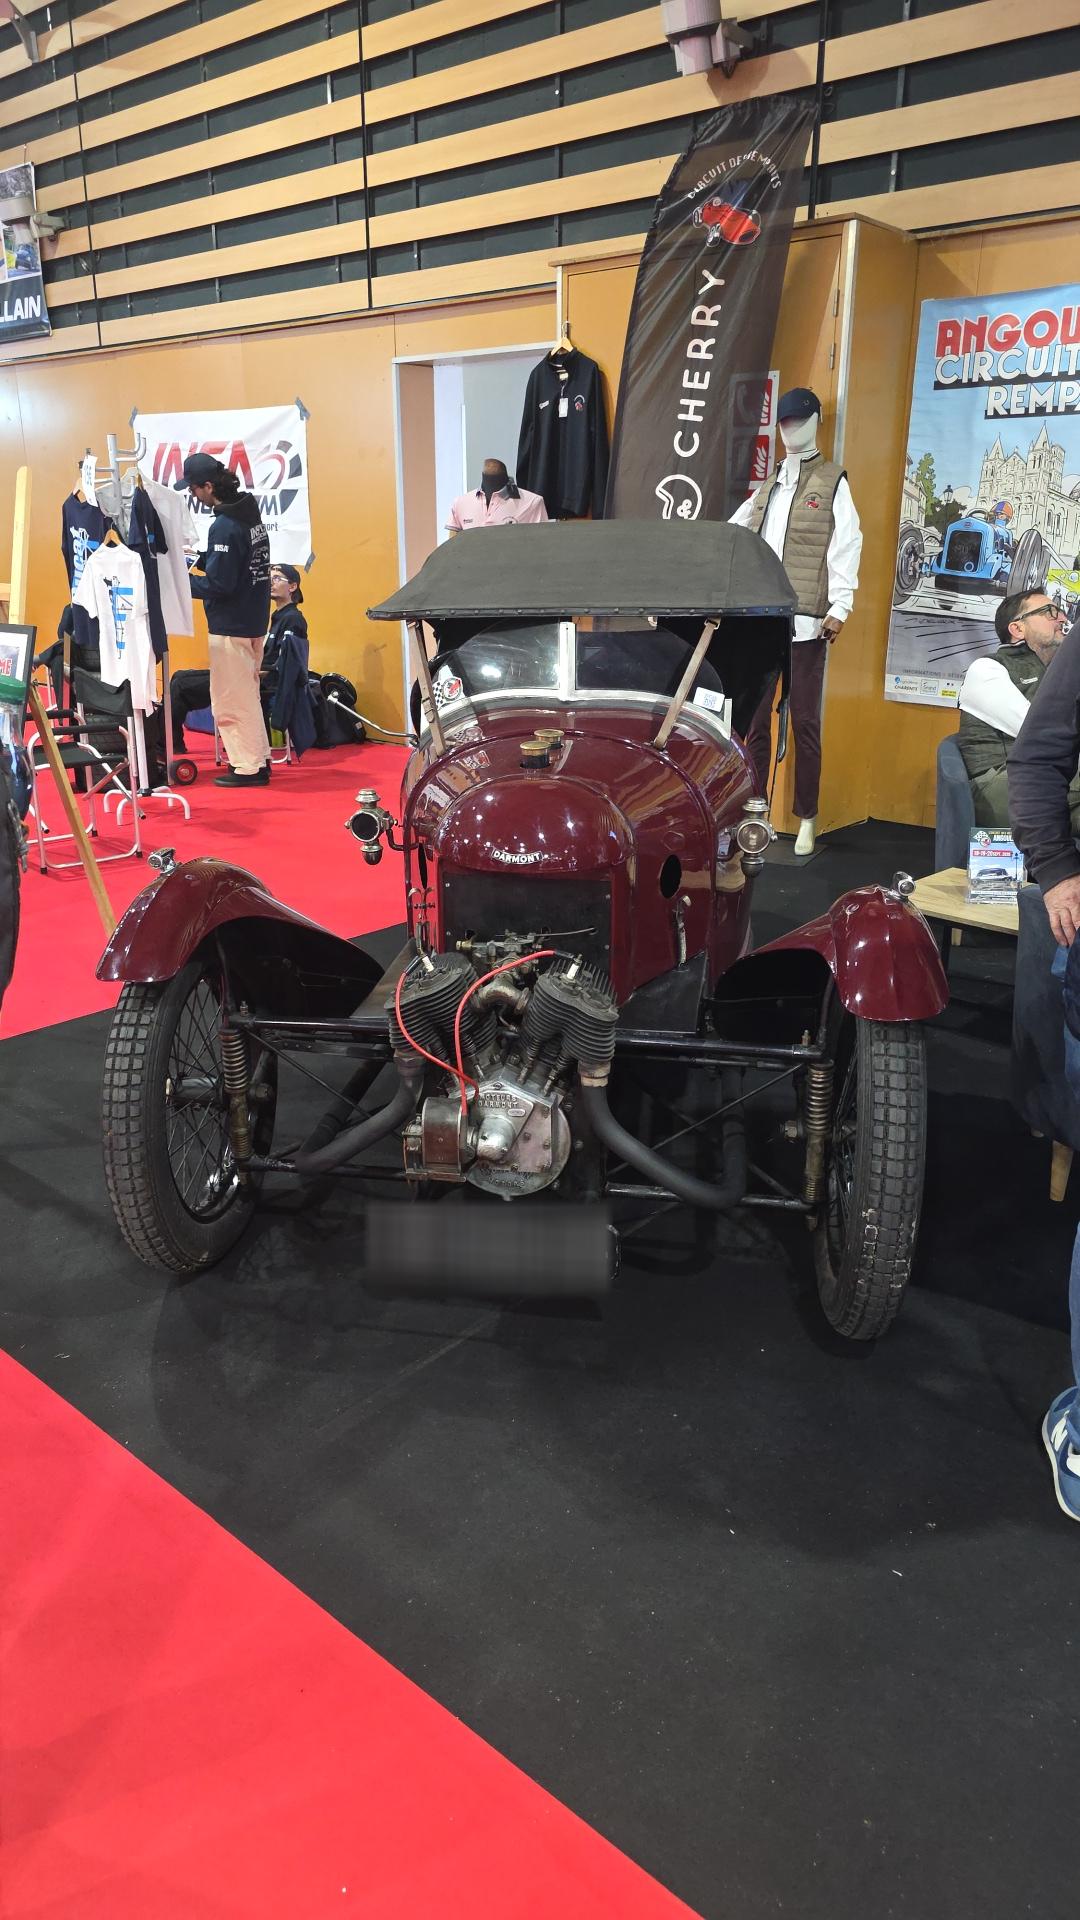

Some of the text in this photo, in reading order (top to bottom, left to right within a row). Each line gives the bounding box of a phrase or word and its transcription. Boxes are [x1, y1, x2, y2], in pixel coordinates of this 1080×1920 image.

[0, 295, 41, 322] LAIN
[673, 269, 726, 458] CHERRY
[935, 342, 1080, 385] CIRCUIT
[986, 378, 1080, 416] REMP
[493, 850, 540, 863] DARMONT
[479, 1093, 517, 1102] MOTEURS
